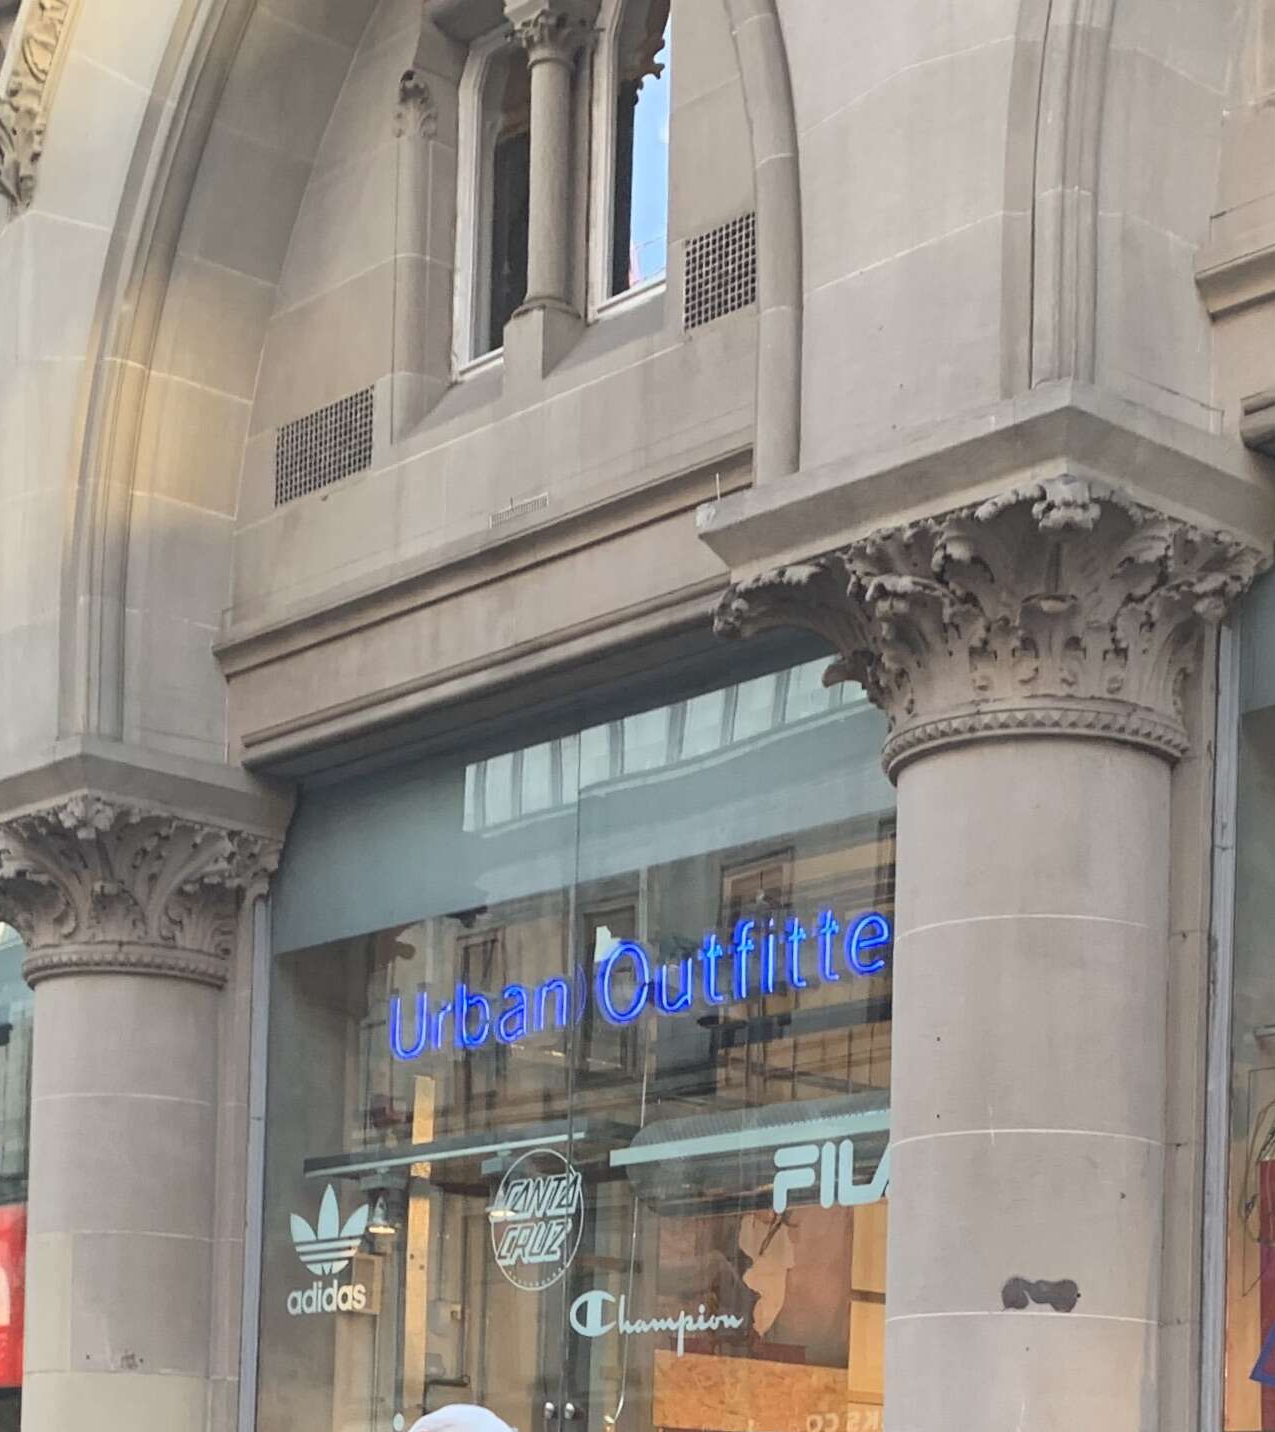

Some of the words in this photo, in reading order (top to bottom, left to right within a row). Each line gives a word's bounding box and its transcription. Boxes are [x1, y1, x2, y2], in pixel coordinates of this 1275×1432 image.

[389, 977, 569, 1061] Urban
[595, 908, 891, 1026] Outfitte
[492, 1172, 582, 1221] SANTA
[496, 1219, 572, 1266] CRUZ
[287, 1279, 366, 1316] adidas
[570, 1290, 744, 1358] Champion
